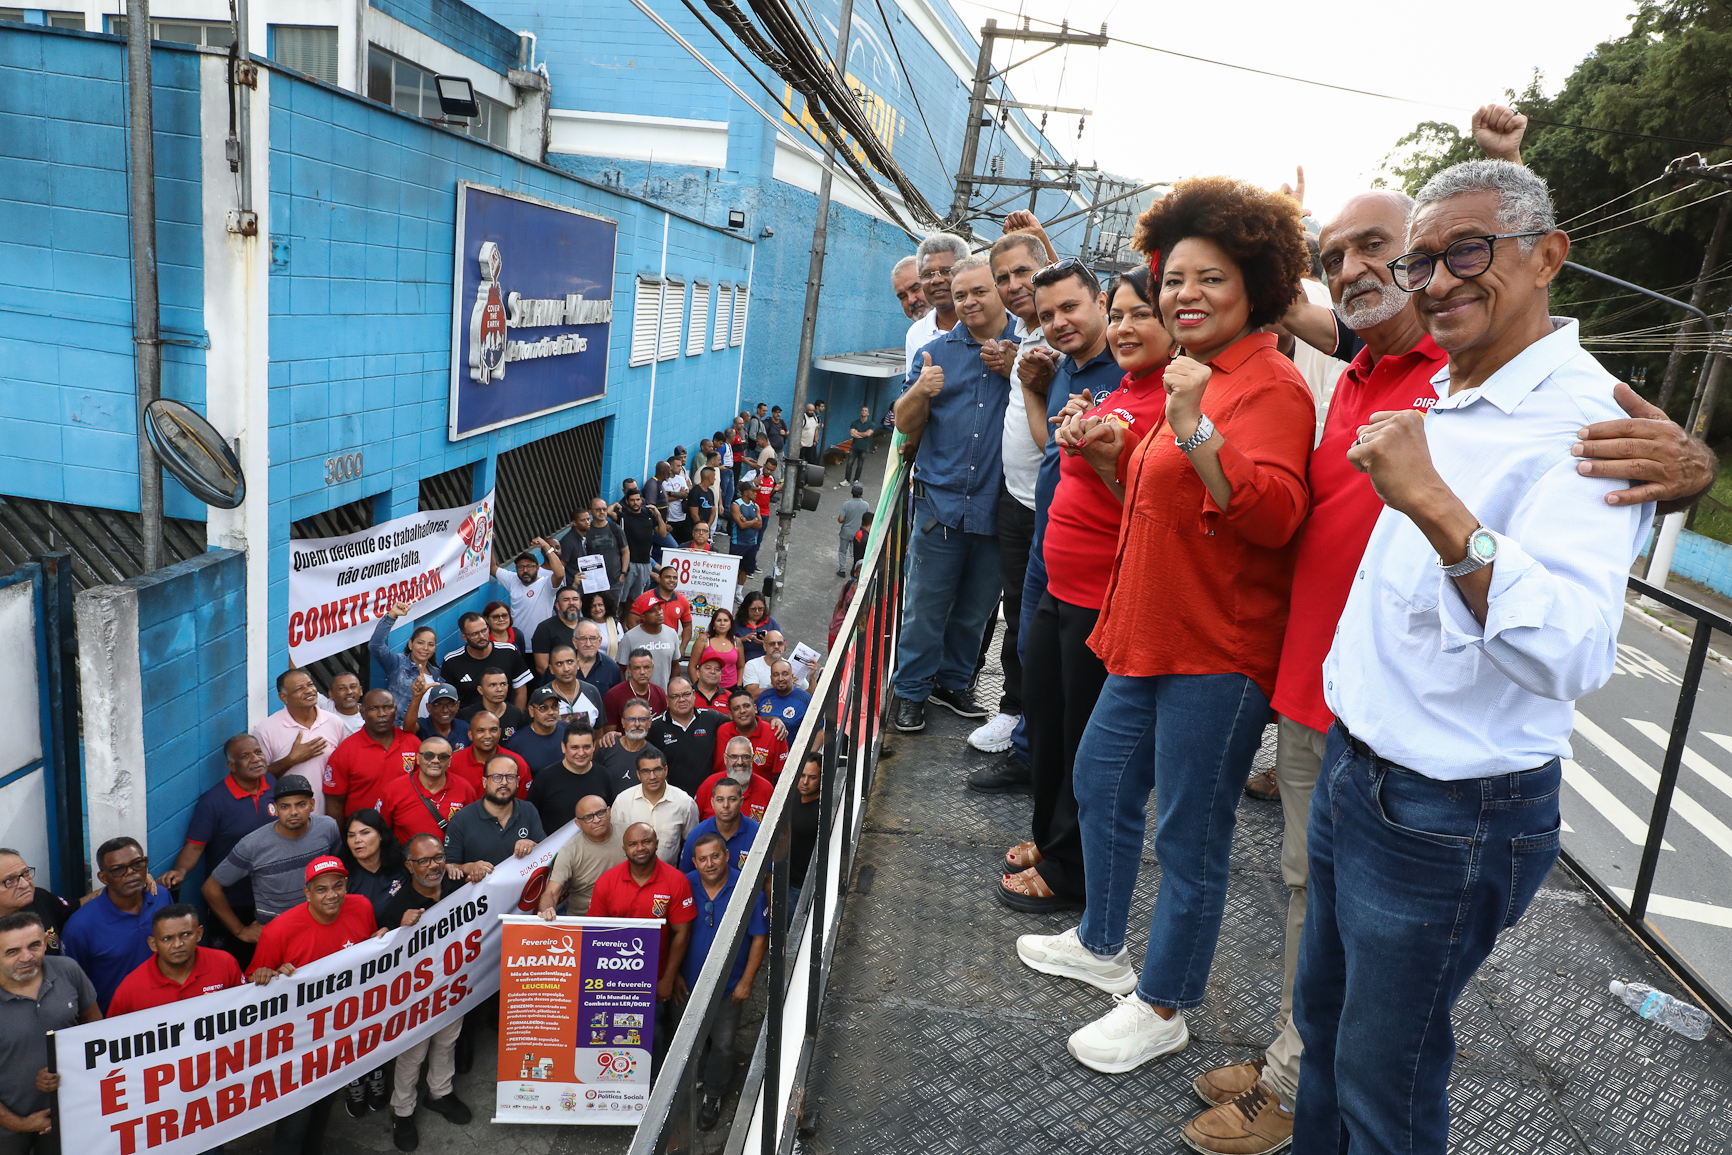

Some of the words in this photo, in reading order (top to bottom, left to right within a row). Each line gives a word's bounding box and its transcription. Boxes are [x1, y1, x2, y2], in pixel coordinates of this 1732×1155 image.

[325, 452, 363, 484] 3000
[294, 549, 328, 572] Quem
[329, 537, 375, 562] defende
[378, 535, 391, 550] os
[394, 520, 449, 547] trabalhadores,
[337, 567, 360, 586] não
[361, 556, 400, 580] comete
[400, 550, 421, 570] falta,
[702, 561, 731, 570] Fevereiro
[289, 591, 369, 647] COMETE
[638, 641, 671, 650] adidas
[761, 705, 773, 713] 20
[520, 861, 538, 877] RUMO
[540, 851, 553, 864] AOS
[592, 940, 628, 948] Fevereiro
[507, 955, 576, 968] LARANJA
[596, 957, 645, 970] ROXO
[84, 1022, 185, 1070] Punir
[194, 992, 289, 1042] quem
[296, 969, 352, 1008] luta
[359, 945, 403, 985] por
[407, 894, 489, 958] direitos
[585, 979, 604, 989] 28
[100, 1067, 129, 1116] É
[143, 1022, 294, 1105] PUNIR
[307, 957, 434, 1041] TODOS
[443, 929, 482, 976] OS
[110, 974, 473, 1155] TRABALHADORES.
